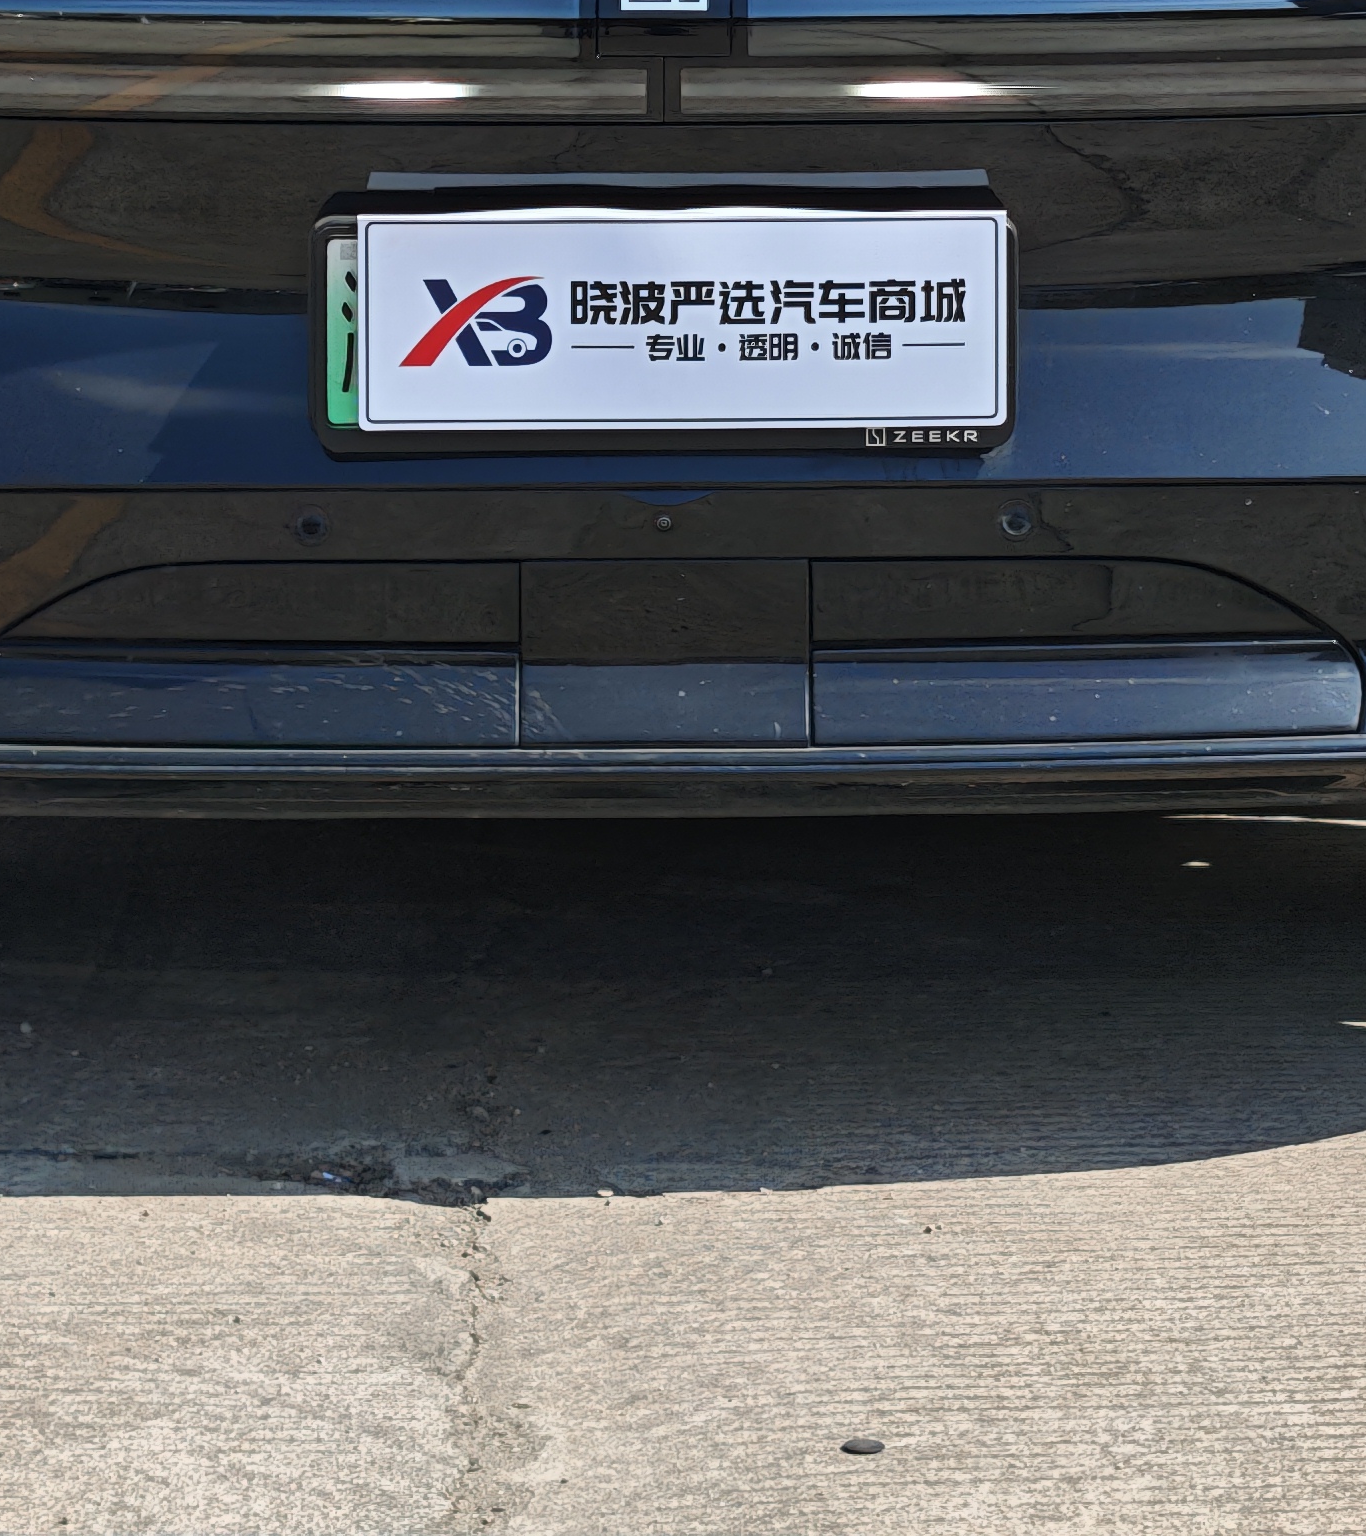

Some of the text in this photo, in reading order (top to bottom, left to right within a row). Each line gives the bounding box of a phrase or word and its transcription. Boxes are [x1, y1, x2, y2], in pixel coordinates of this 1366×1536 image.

[570, 278, 966, 325] 晓波严选汽车商城
[893, 430, 978, 443] ZEEKR
